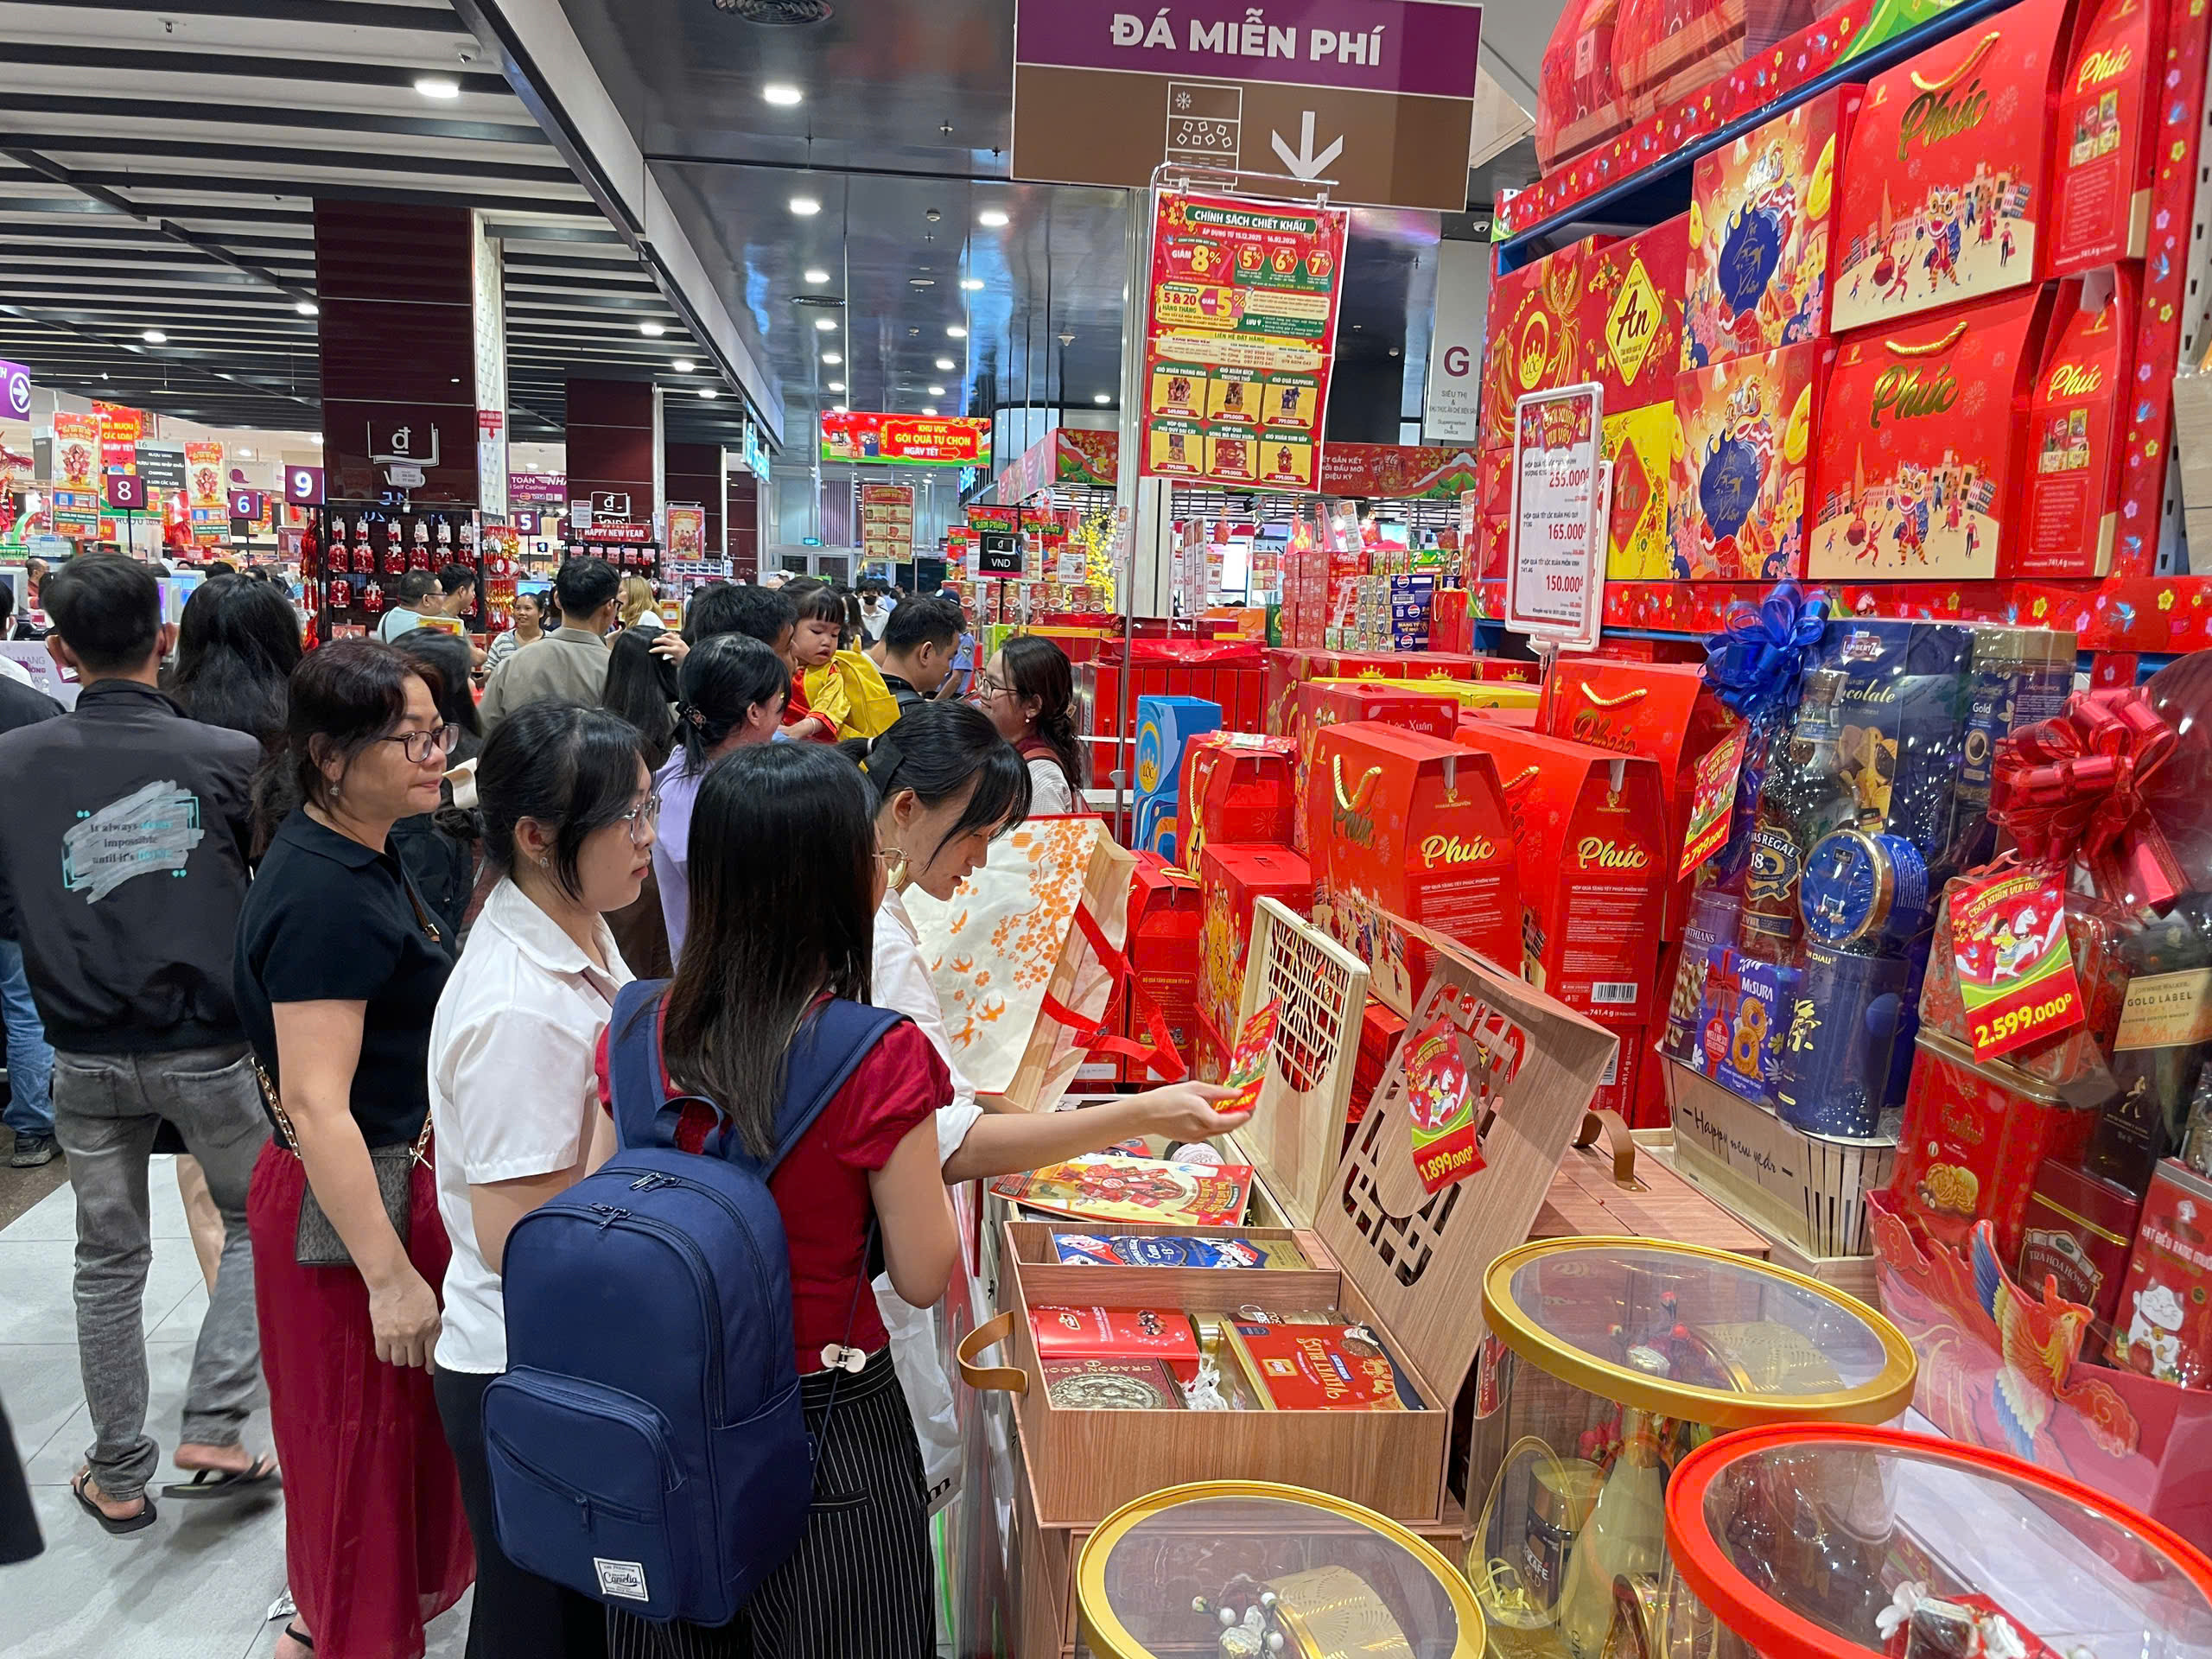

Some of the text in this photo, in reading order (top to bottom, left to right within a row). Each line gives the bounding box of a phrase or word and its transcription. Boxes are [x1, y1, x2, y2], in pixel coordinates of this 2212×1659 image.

[1110, 8, 1385, 67] ĐÁ MIỄN PHÍ
[2076, 43, 2132, 93] Phúc
[1897, 79, 1990, 162] Phúc
[1194, 209, 1224, 224] CHÍNH
[1225, 213, 1249, 227] SÁCH
[1251, 216, 1278, 230] CHIẾT
[1192, 245, 1221, 272] 8%
[1242, 251, 1261, 268] 5%
[1275, 254, 1294, 270] 6%
[1311, 257, 1329, 274] 7%
[1164, 292, 1197, 306] 5 & 20
[1216, 289, 1246, 318] 5%
[1617, 289, 1650, 346] An
[1444, 346, 1470, 378] G
[2046, 364, 2102, 402] Phúc
[1870, 364, 1960, 429] Phúc
[1348, 454, 1363, 464] KẾT
[117, 480, 132, 501] 8
[294, 472, 313, 497] 9
[512, 474, 536, 485] TOÁN
[237, 495, 251, 513] 6
[520, 514, 532, 531] 5
[584, 527, 644, 538] HAPPY NEW YEAR
[1548, 522, 1586, 540] 165.000đ
[991, 558, 1011, 568] VND
[1546, 575, 1583, 593] 150.000đ
[1843, 678, 1896, 703] colate
[1973, 702, 1992, 715] Gold
[1409, 721, 1433, 733] Xuân
[1421, 834, 1497, 869] Phúc
[1577, 836, 1650, 870] Phúc
[1762, 833, 1796, 858] REGAL
[1751, 852, 1764, 869] 18
[2127, 990, 2193, 1007] GOLD LABEL
[1589, 1008, 1608, 1017] 741,4
[1694, 1106, 1777, 1185] Happy new year
[2046, 1255, 2063, 1273] HOA
[1296, 1338, 1327, 1362] BLISS
[1087, 1364, 1153, 1373] DRAGON
[1313, 1360, 1349, 1400] VELVET
